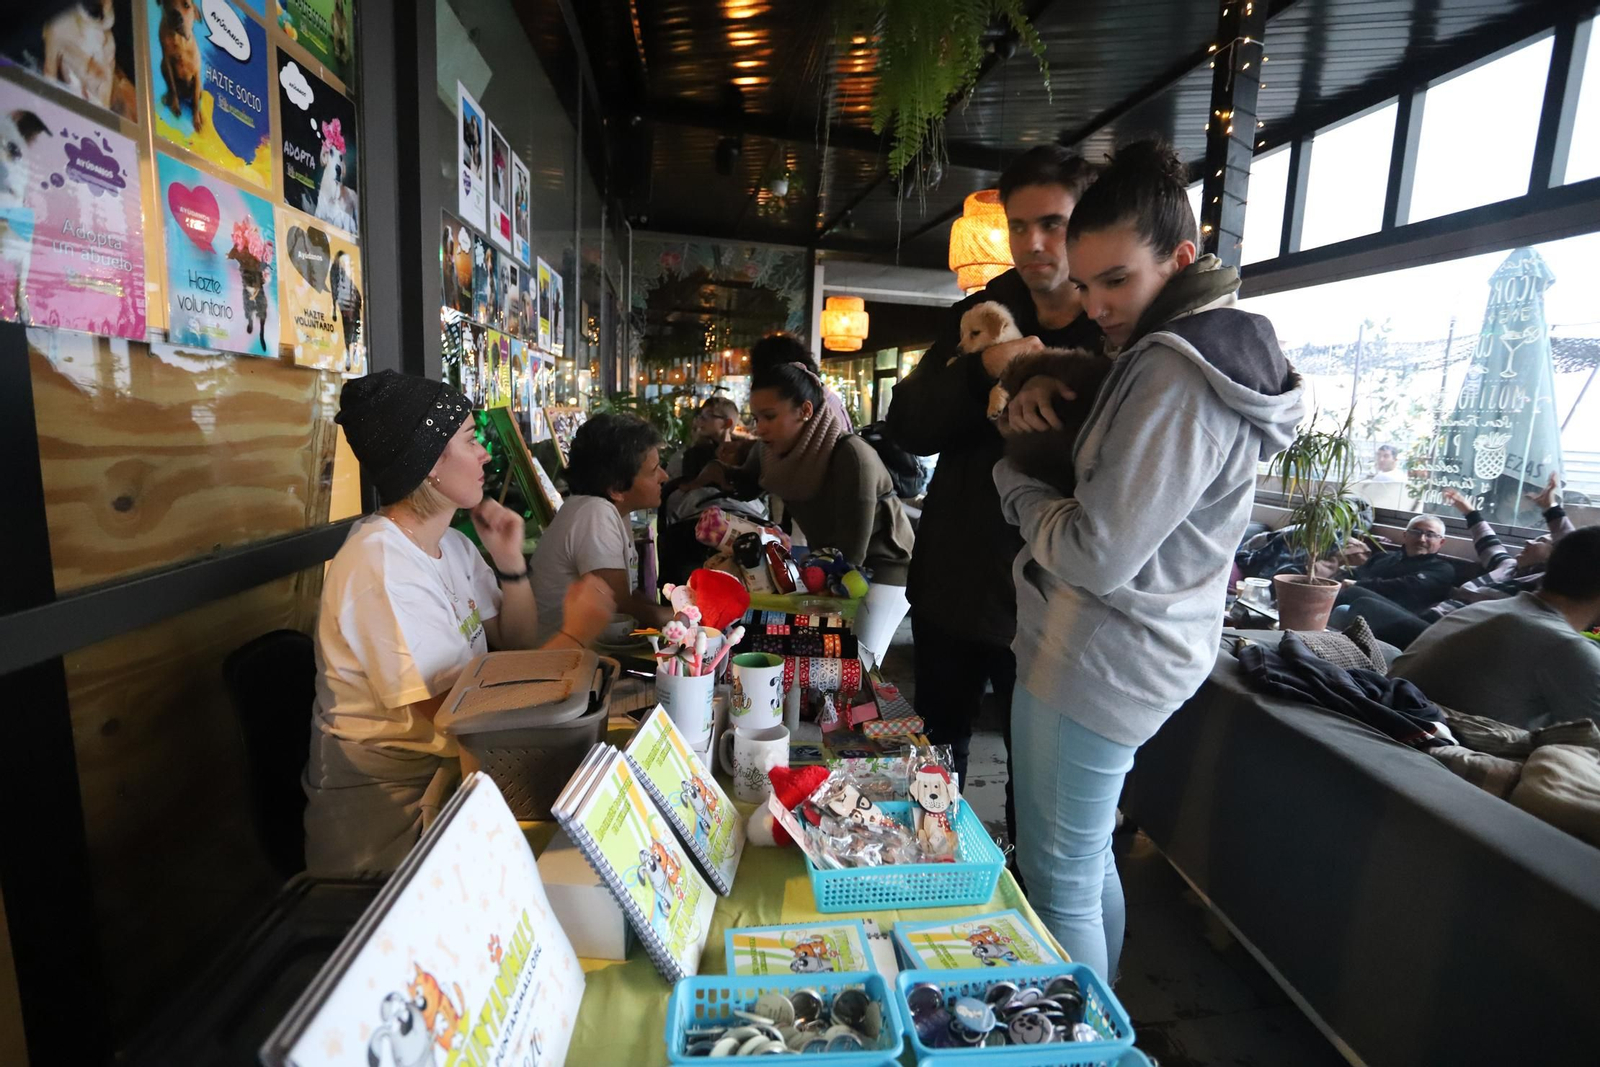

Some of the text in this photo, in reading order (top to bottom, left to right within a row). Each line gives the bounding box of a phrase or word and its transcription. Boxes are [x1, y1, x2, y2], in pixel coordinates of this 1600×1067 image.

[205, 64, 262, 113] HAZTE SOCIO
[283, 140, 316, 170] ADOPTA
[62, 218, 123, 251] Adopta
[52, 240, 133, 272] un abuelo
[188, 268, 222, 295] Hazte
[176, 294, 234, 320] voluntario
[303, 308, 325, 322] HAZTE
[294, 316, 335, 333] VOLUNTARIO
